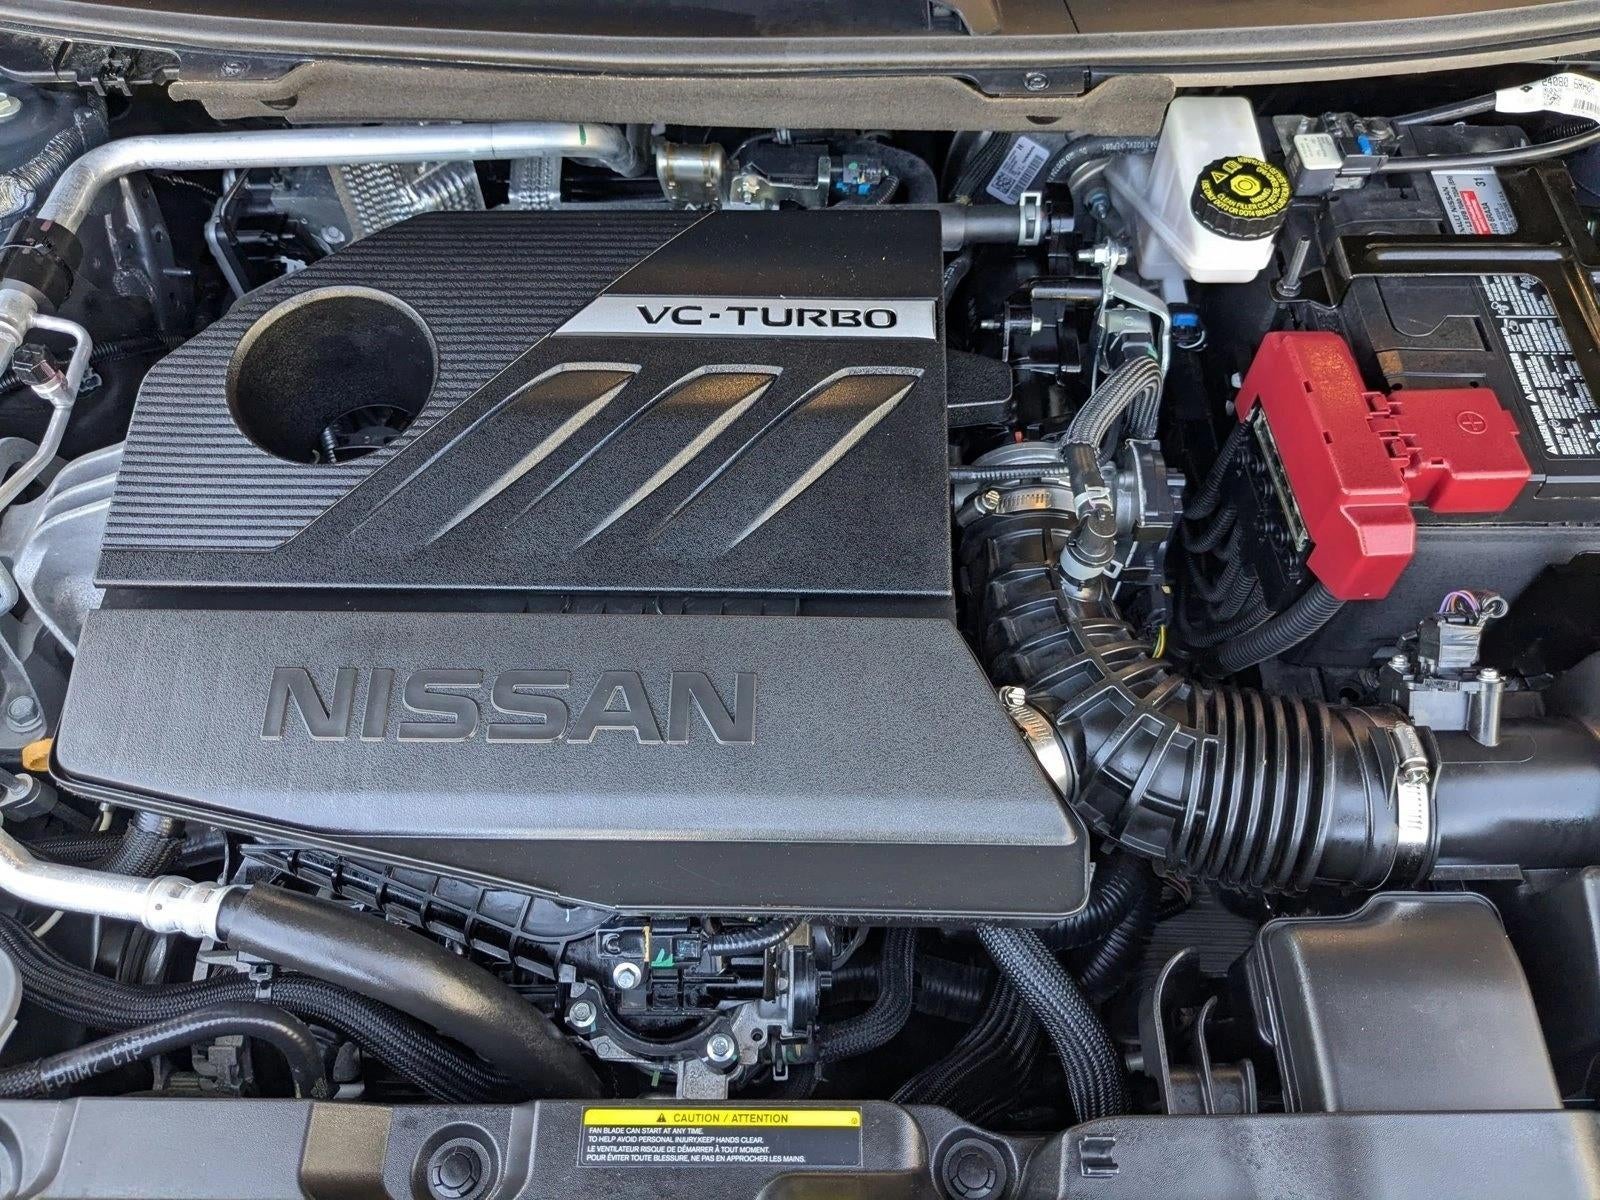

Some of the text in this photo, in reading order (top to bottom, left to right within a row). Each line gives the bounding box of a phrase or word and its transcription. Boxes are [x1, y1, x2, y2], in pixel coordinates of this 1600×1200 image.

[1473, 177, 1486, 187] 31
[1217, 193, 1237, 206] CLEAN
[636, 305, 898, 328] VC-TURBO
[260, 666, 758, 745] NISSAN
[673, 1113, 720, 1123] CAUTION
[731, 1114, 788, 1124] ATTENTION
[677, 1144, 713, 1153] DÉMARRER
[607, 1153, 629, 1161] ÉVITER
